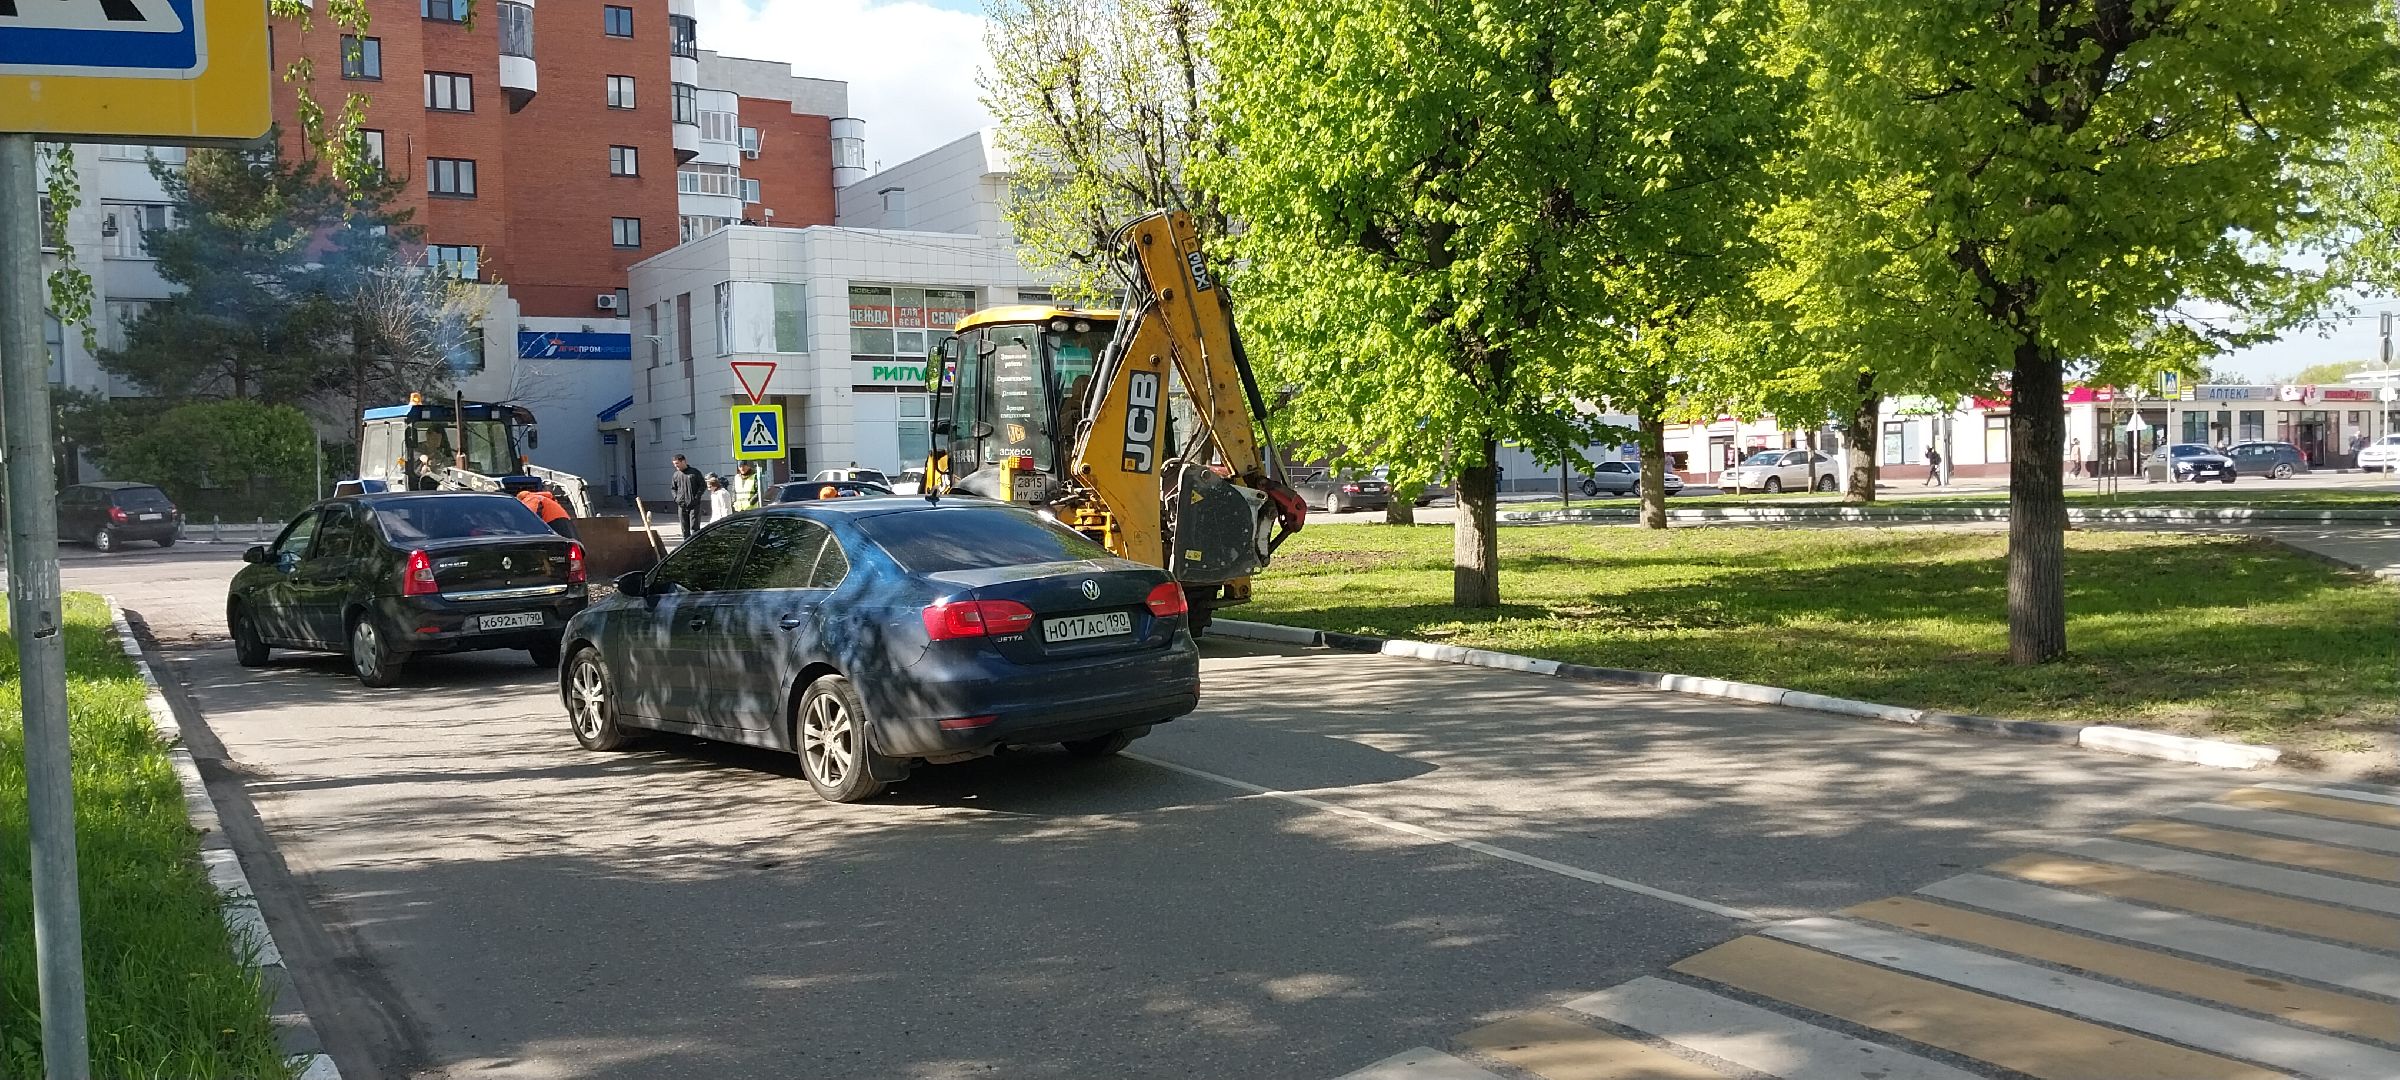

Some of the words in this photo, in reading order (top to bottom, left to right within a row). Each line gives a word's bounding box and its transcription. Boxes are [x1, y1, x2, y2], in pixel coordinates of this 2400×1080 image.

[900, 308, 918, 317] ДЛЯ
[872, 366, 927, 381] РИГЛ
[2208, 388, 2250, 399] АПТЕКА
[1126, 373, 1157, 472] JCB
[1017, 477, 1042, 488] 2815
[525, 613, 540, 622] 790
[1048, 618, 1105, 639] Н017АС
[1106, 614, 1126, 627] 190
